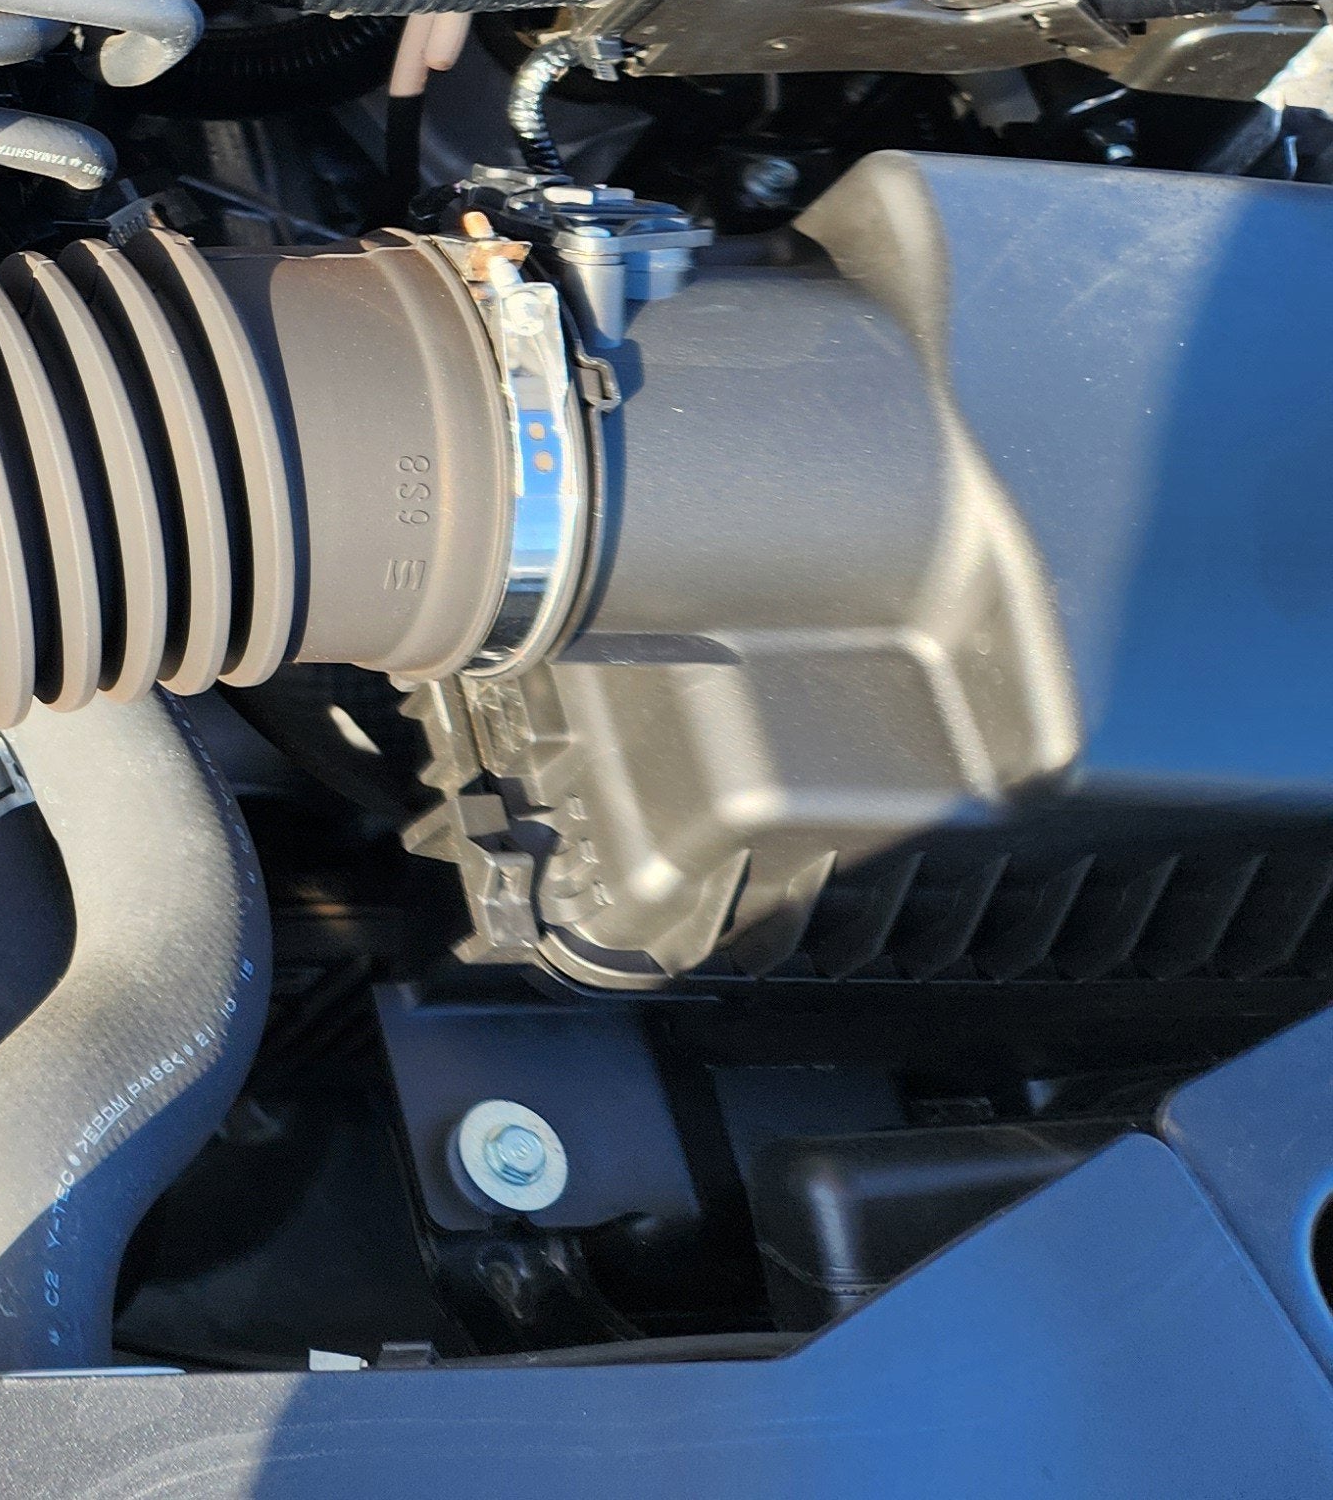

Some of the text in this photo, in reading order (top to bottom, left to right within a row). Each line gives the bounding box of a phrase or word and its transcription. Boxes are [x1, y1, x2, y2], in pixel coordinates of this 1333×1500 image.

[396, 454, 431, 525] 6S8
[218, 996, 239, 1021] 10
[46, 1169, 76, 1248] Y-TEC
[42, 1267, 61, 1307] C2
